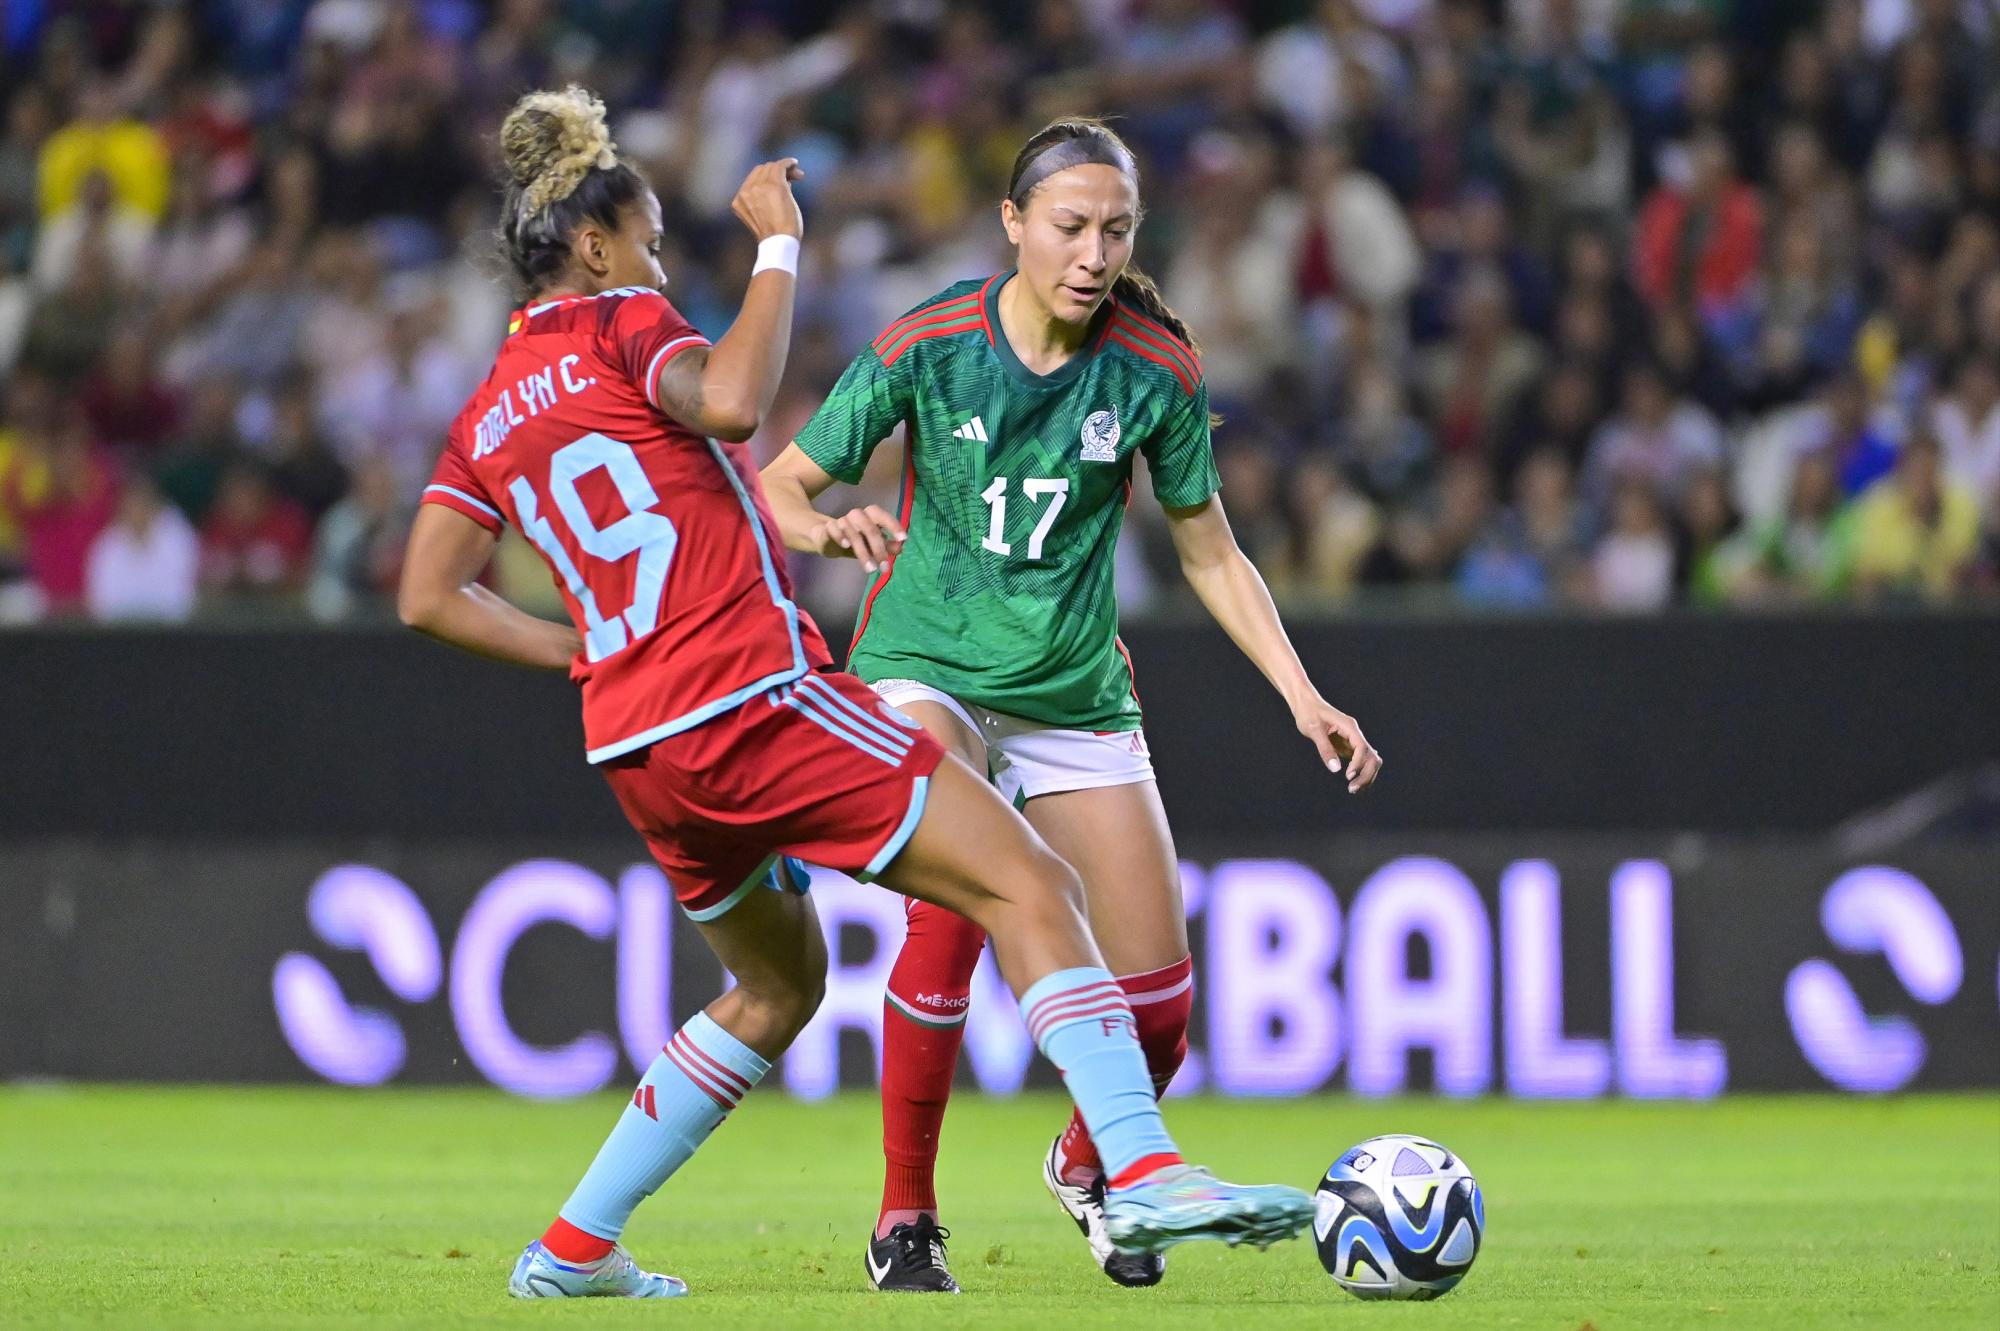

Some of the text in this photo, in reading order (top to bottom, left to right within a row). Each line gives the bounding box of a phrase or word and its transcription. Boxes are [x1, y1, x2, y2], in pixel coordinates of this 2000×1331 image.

[560, 354, 596, 394] C.
[508, 431, 678, 664] 19
[980, 476, 1069, 560] 17
[449, 857, 1729, 1099] CURVBALL
